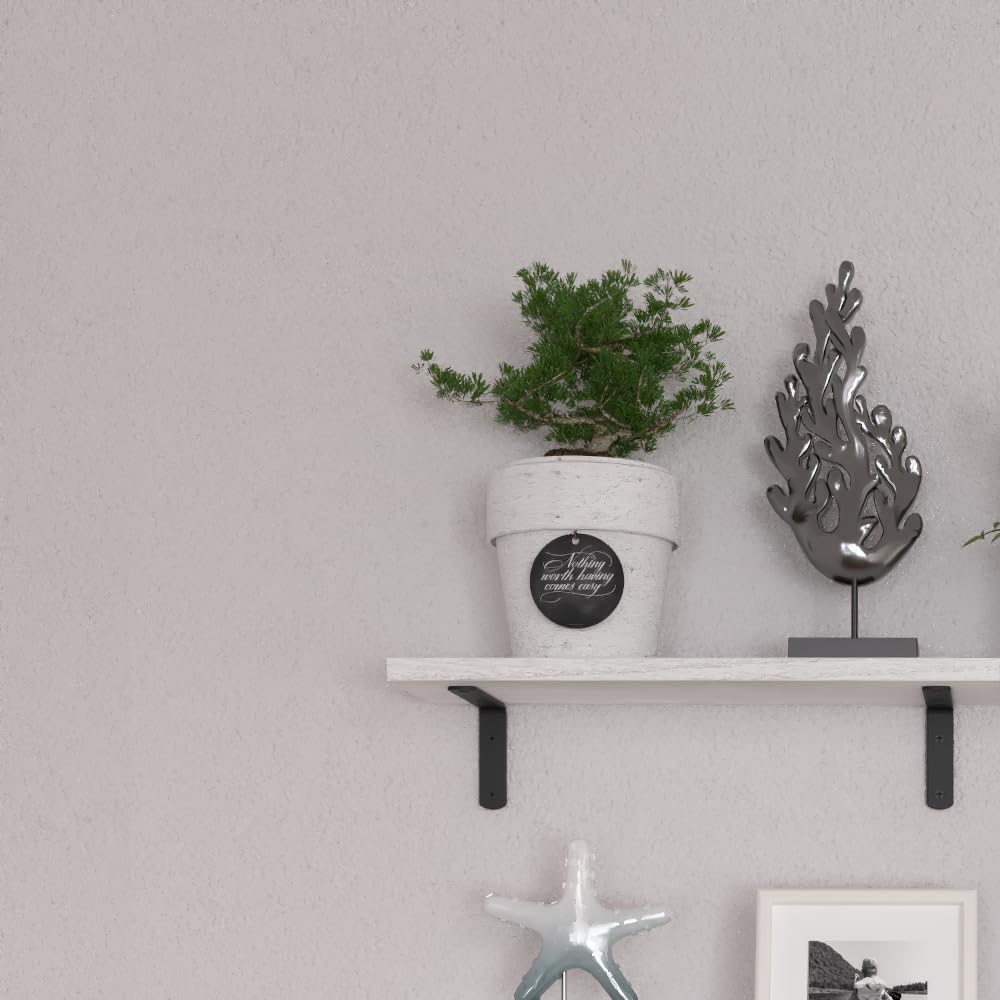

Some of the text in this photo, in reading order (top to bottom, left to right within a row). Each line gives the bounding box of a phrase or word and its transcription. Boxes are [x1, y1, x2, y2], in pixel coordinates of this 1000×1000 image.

[541, 569, 614, 585] worth having
[578, 583, 601, 598] easy
